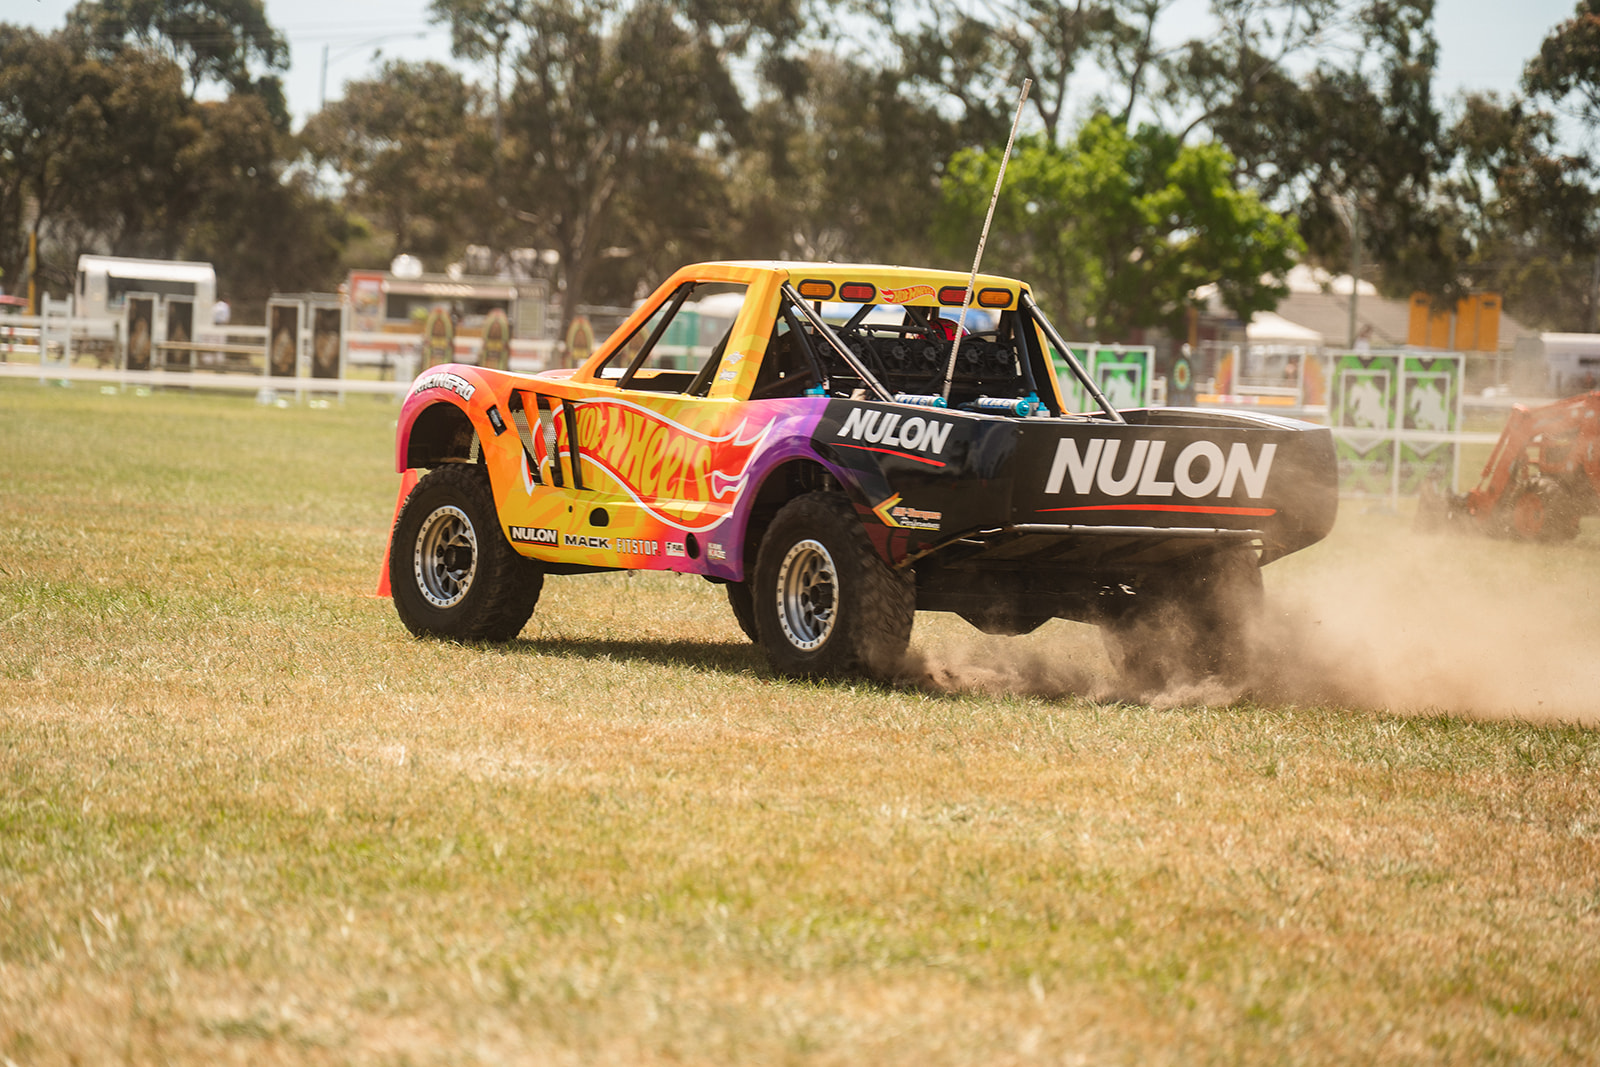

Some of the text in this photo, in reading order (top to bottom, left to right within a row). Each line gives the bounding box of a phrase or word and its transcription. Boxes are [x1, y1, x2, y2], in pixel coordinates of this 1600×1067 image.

[837, 407, 954, 455] NULON
[1044, 438, 1278, 499] NULON
[512, 527, 557, 543] NULON
[564, 534, 610, 549] MACK
